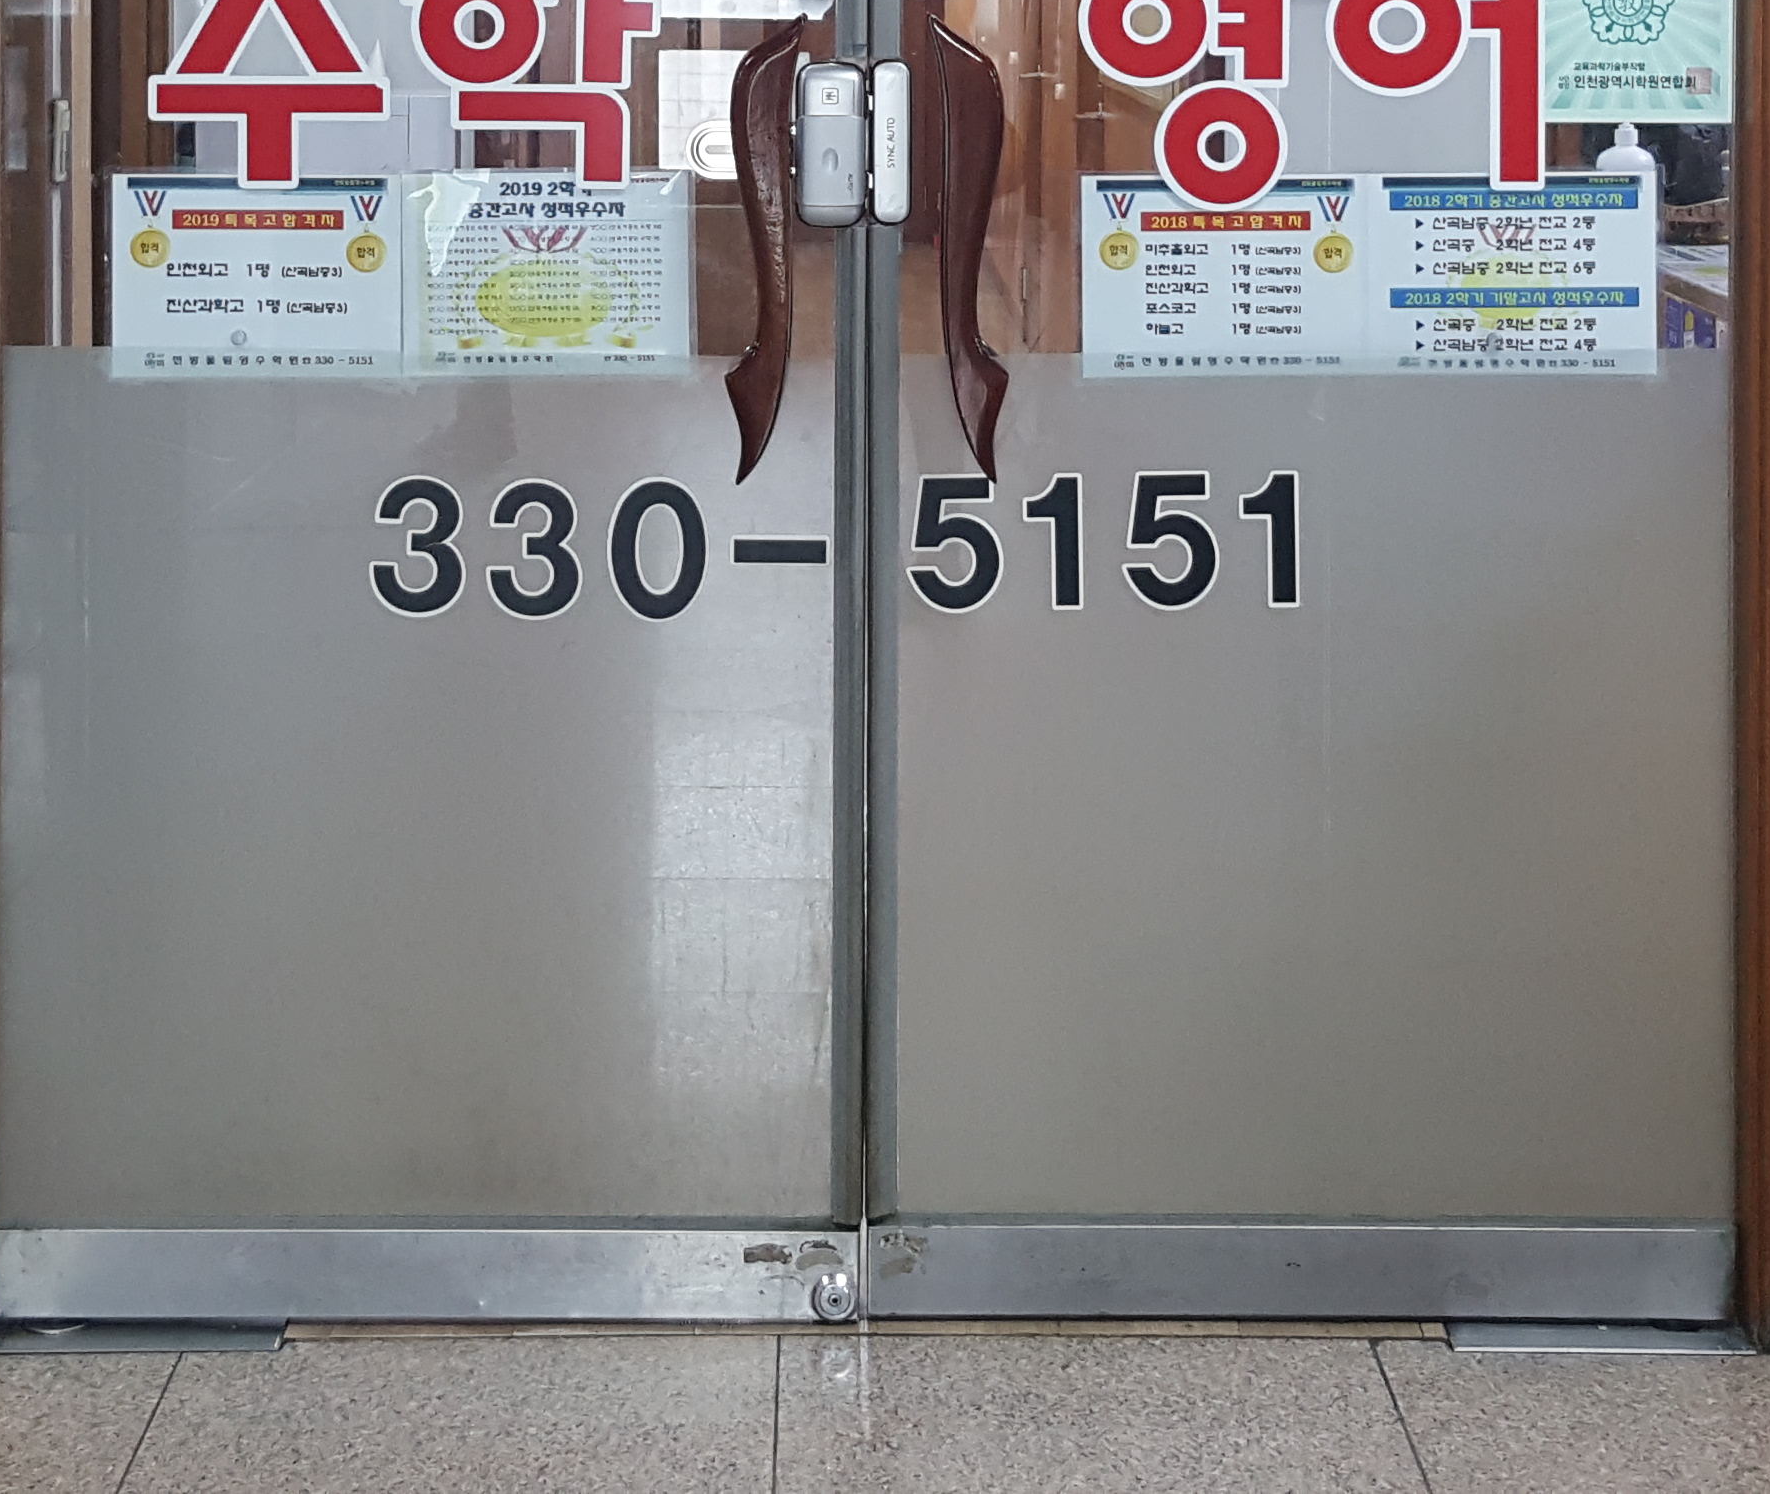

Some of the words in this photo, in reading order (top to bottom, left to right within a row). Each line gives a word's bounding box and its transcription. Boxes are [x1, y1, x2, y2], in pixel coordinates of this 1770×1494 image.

[1574, 75, 1696, 90] 인천광역시학원연합회
[886, 117, 895, 143] AUTO
[886, 144, 895, 169] SYNC
[499, 182, 542, 196] 2019
[548, 181, 593, 197] 2학
[1404, 194, 1441, 207] 2018
[1446, 194, 1484, 207] 2학기
[541, 201, 626, 218] 성적우수자
[183, 213, 219, 227] 2019
[1151, 215, 1188, 229] 2018
[1495, 216, 1533, 230] 2학년
[1539, 216, 1567, 230] 전교
[1572, 216, 1596, 230] 2등
[140, 242, 160, 254] 합격
[1109, 244, 1129, 256] 합격
[1231, 244, 1251, 256] 1명
[1495, 238, 1533, 252] 2학년
[1539, 238, 1567, 252] 전교
[1572, 238, 1596, 252] 4등
[356, 247, 376, 258] 합격
[1323, 247, 1343, 259] 합격
[166, 262, 229, 277] 인천외고
[247, 263, 270, 278] 1명
[1145, 264, 1196, 276] 인천외고
[1231, 264, 1251, 276] 1명
[1495, 261, 1533, 275] 2학년
[1539, 261, 1567, 275] 전교
[1572, 261, 1596, 275] 6등
[1145, 282, 1209, 294] 진산과학고
[1231, 282, 1251, 294] 1명
[1405, 292, 1441, 305] 2018
[1446, 292, 1484, 305] 2학기
[166, 298, 245, 314] 진산과학고
[257, 298, 281, 314] 1명
[1145, 303, 1196, 314] 포스코고
[1231, 303, 1251, 314] 1명
[1145, 323, 1184, 335] 하늘고
[1231, 323, 1251, 335] 1명
[1495, 318, 1533, 331] 2학년
[1539, 318, 1567, 331] 전교
[1572, 318, 1596, 331] 2등
[1495, 338, 1533, 352] 2학년
[1539, 338, 1567, 352] 전교
[1572, 338, 1596, 352] 4등
[905, 469, 1300, 614] 5151
